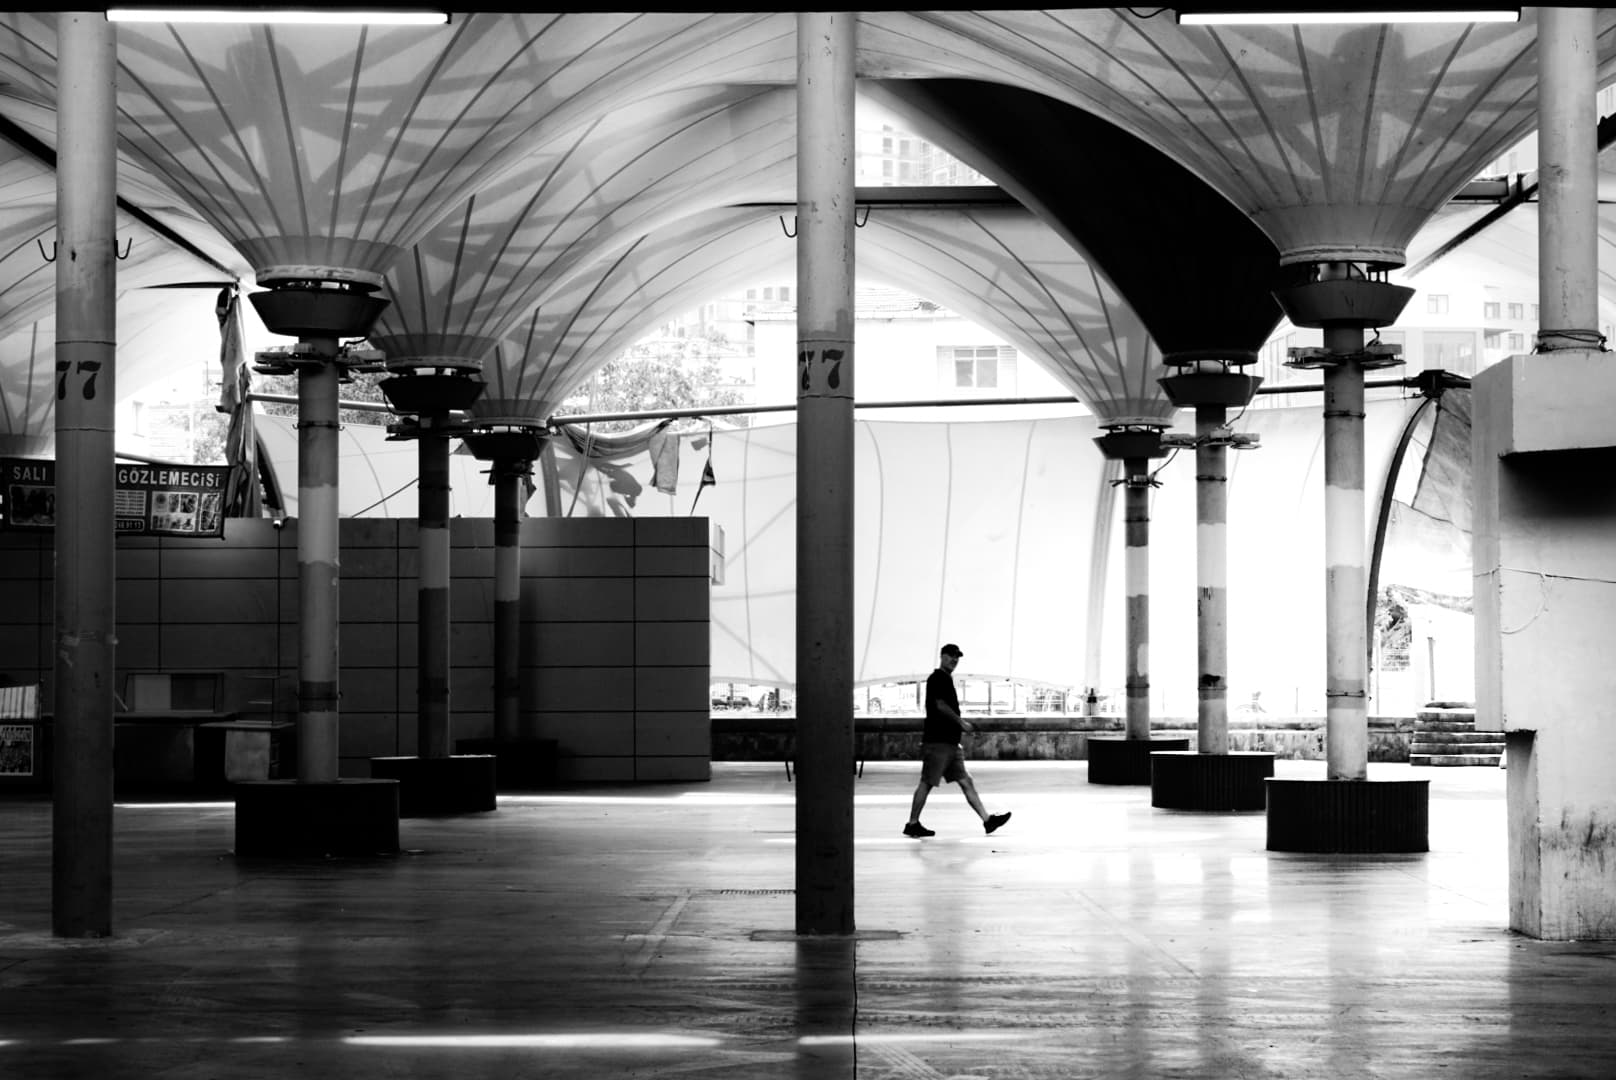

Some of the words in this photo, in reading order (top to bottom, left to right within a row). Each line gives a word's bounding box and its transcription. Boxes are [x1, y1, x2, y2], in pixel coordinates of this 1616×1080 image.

[56, 361, 101, 400] 77
[799, 349, 844, 390] 77
[13, 466, 47, 481] SALI
